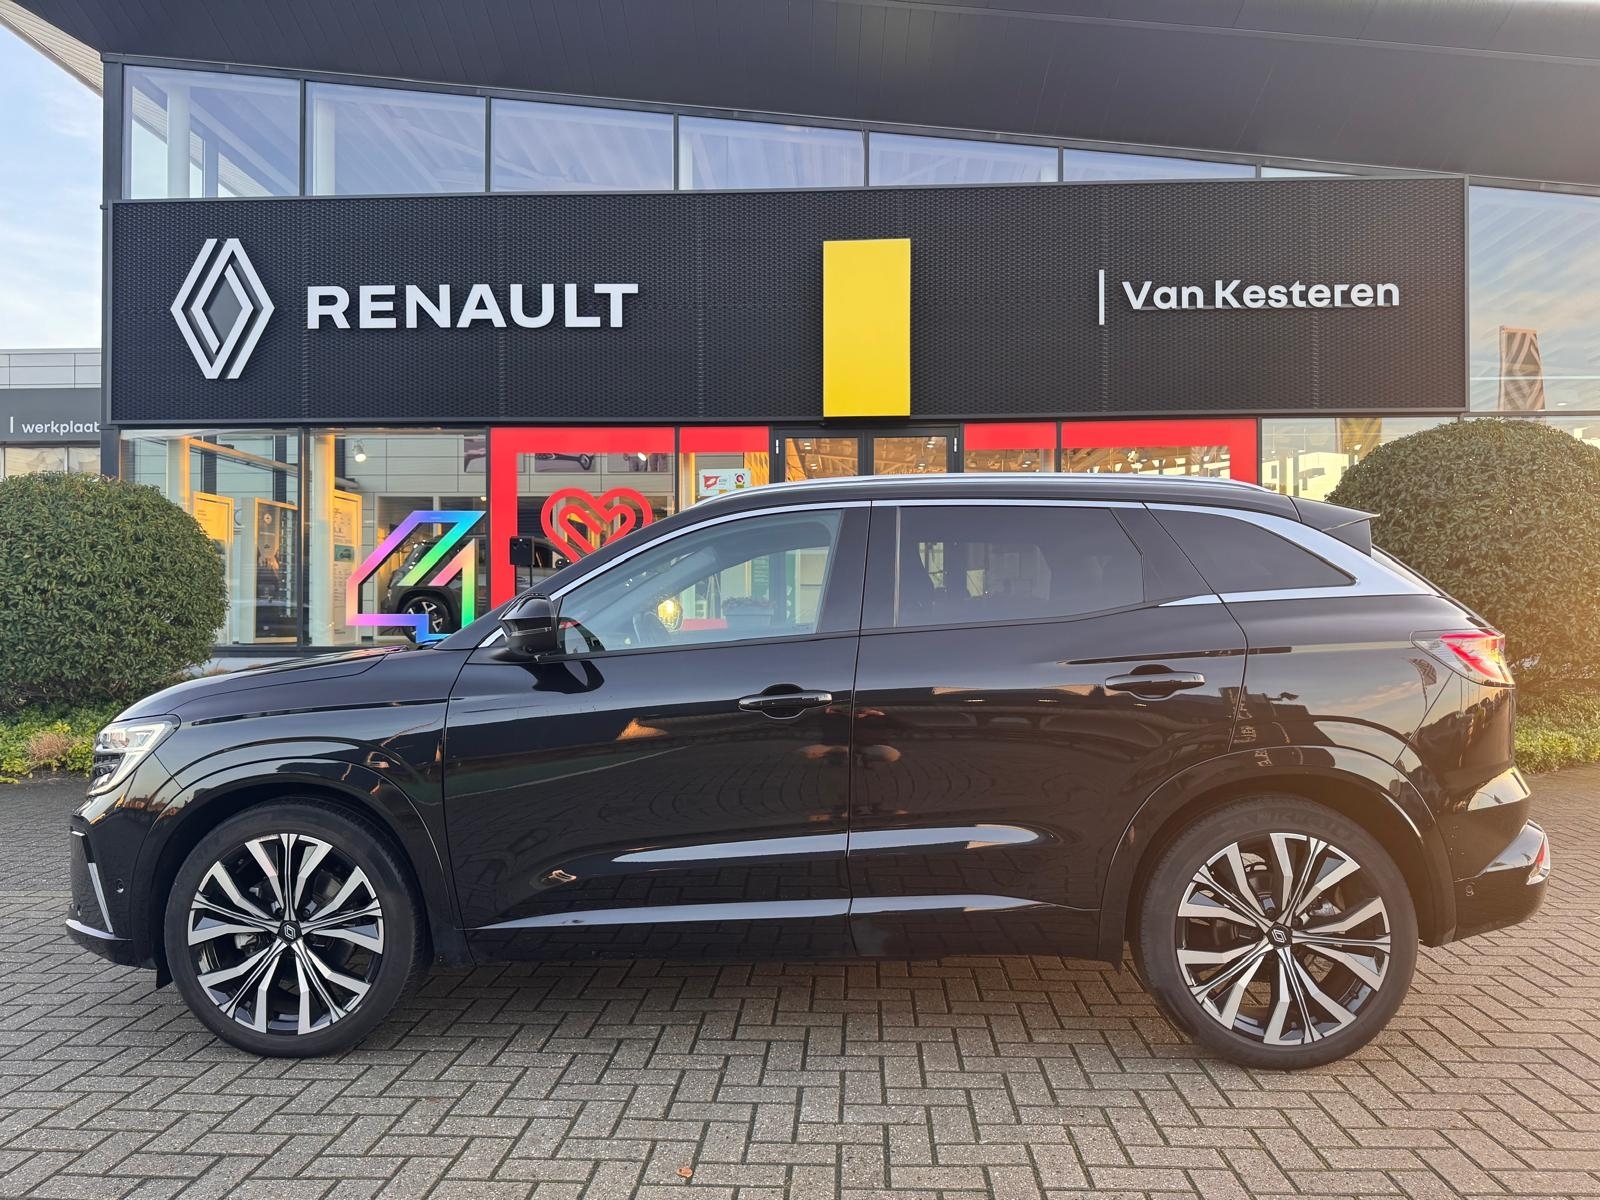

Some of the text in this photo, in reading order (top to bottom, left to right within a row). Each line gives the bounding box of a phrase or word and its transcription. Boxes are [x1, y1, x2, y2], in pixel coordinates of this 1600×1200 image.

[307, 283, 638, 330] RENAULT
[1121, 279, 1399, 310] Van Kesteren
